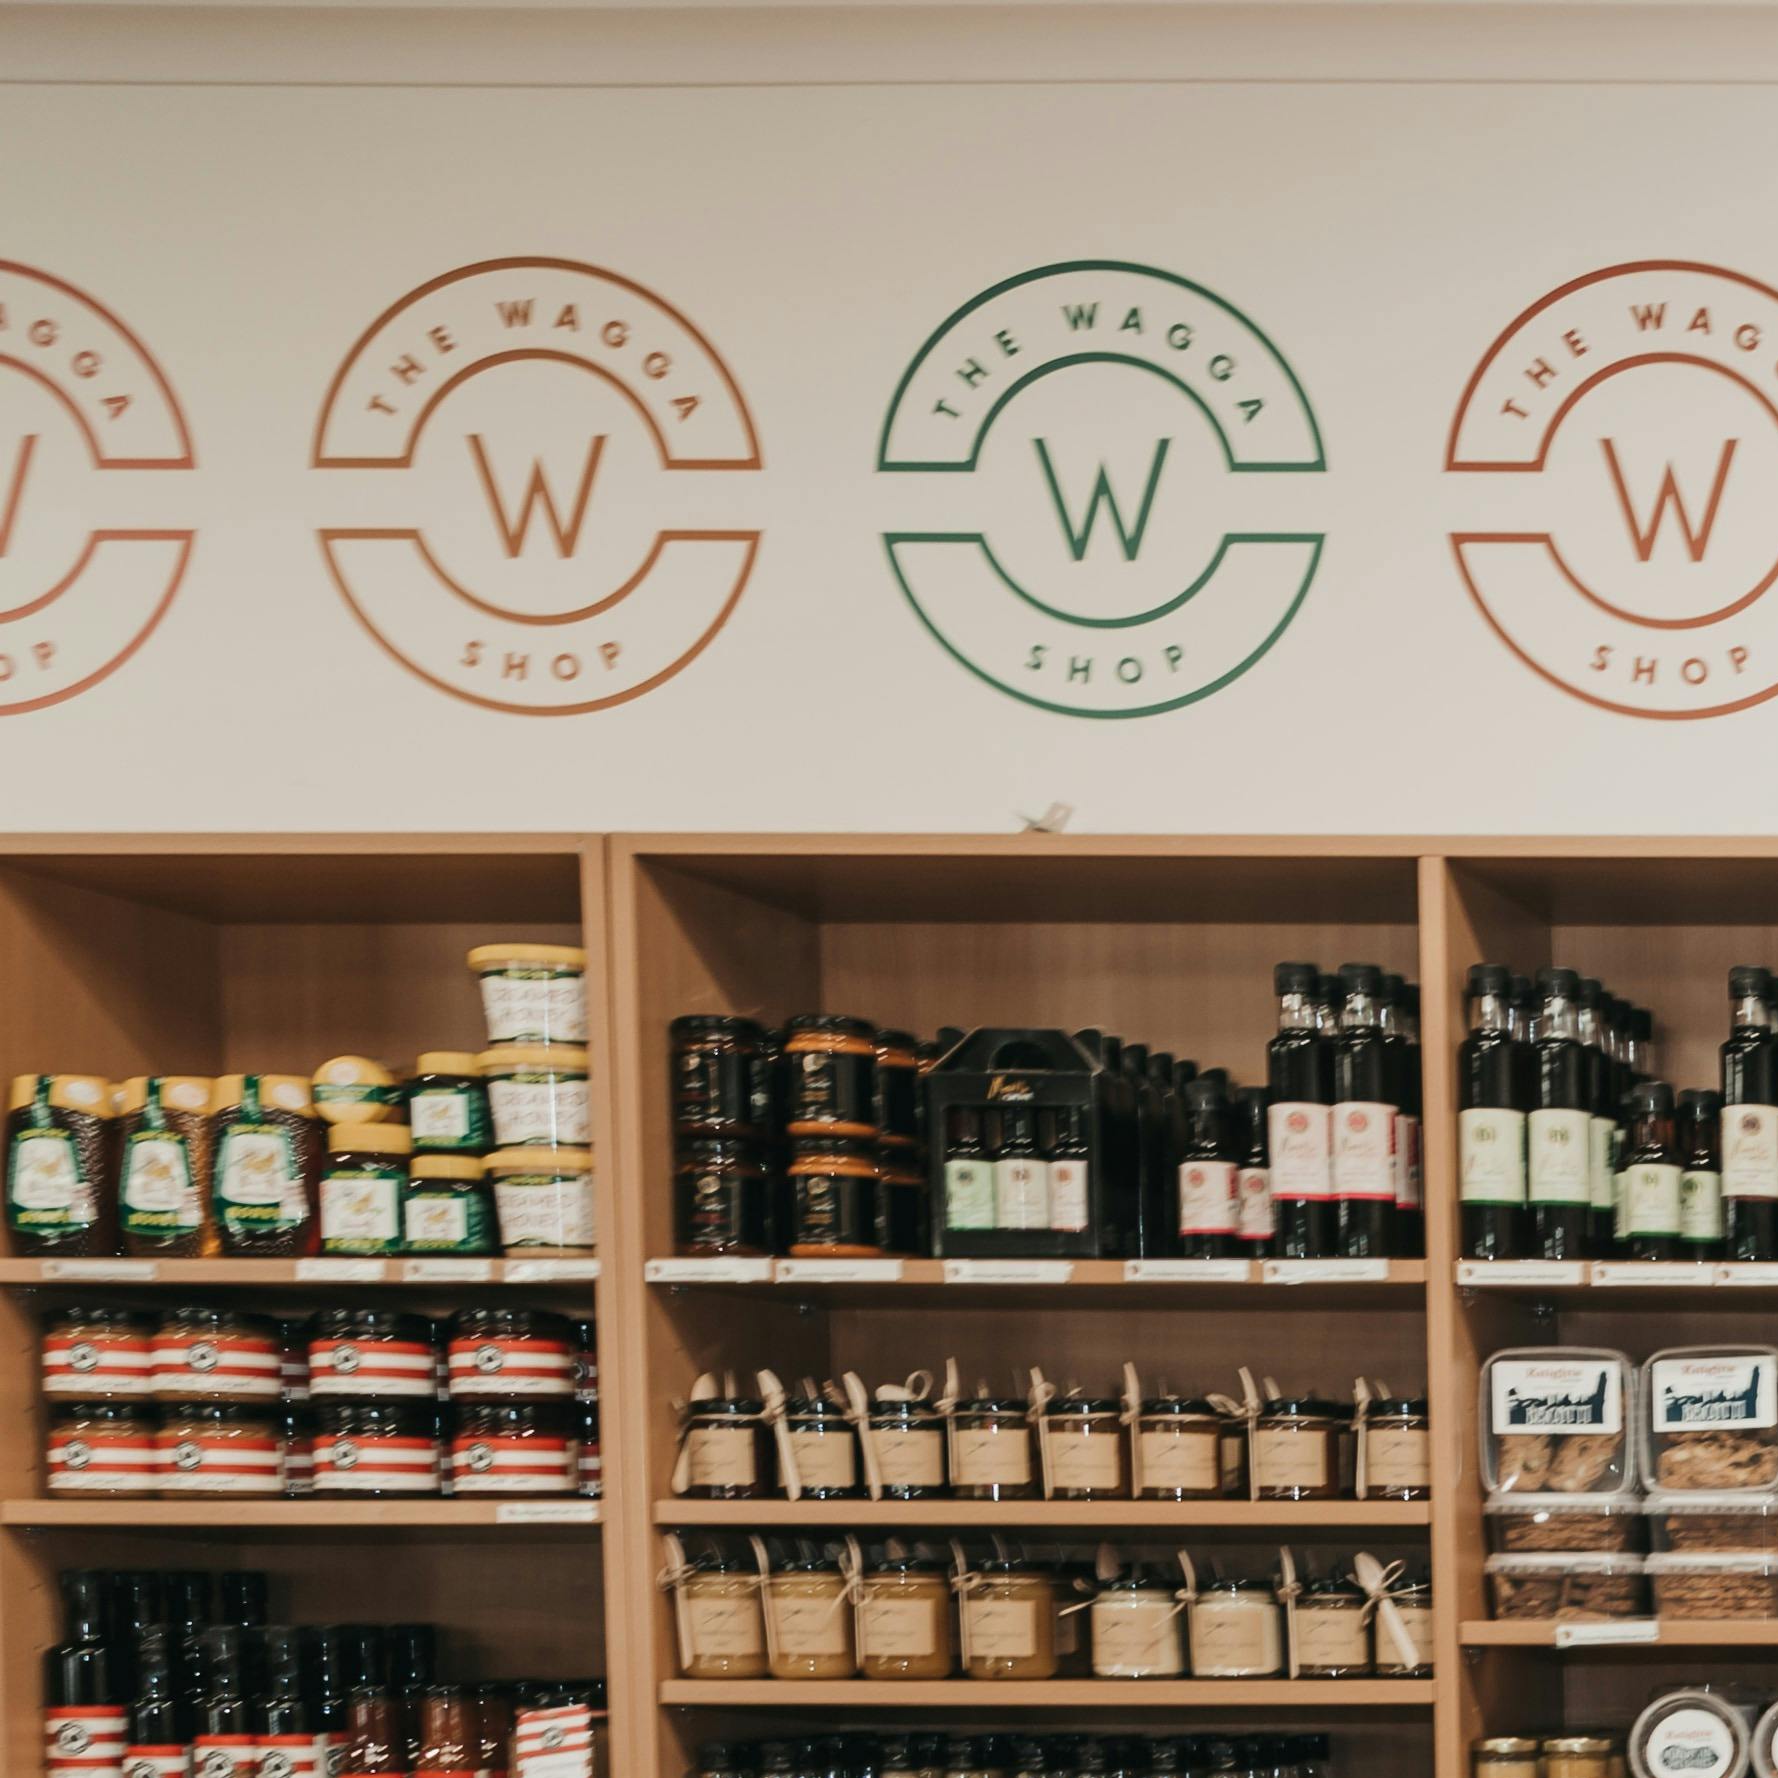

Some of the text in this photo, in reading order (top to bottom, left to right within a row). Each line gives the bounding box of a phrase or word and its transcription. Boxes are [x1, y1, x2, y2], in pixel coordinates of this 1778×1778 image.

[365, 296, 705, 426] THE WAGGA
[930, 298, 1268, 427] THE WAGGA
[1497, 325, 1592, 425] THE
[464, 432, 610, 561] W
[1030, 435, 1174, 564] W
[1597, 436, 1741, 565] W
[459, 638, 622, 684] SHOP
[1022, 643, 1185, 688] SHOP
[1588, 644, 1751, 688] SHOP
